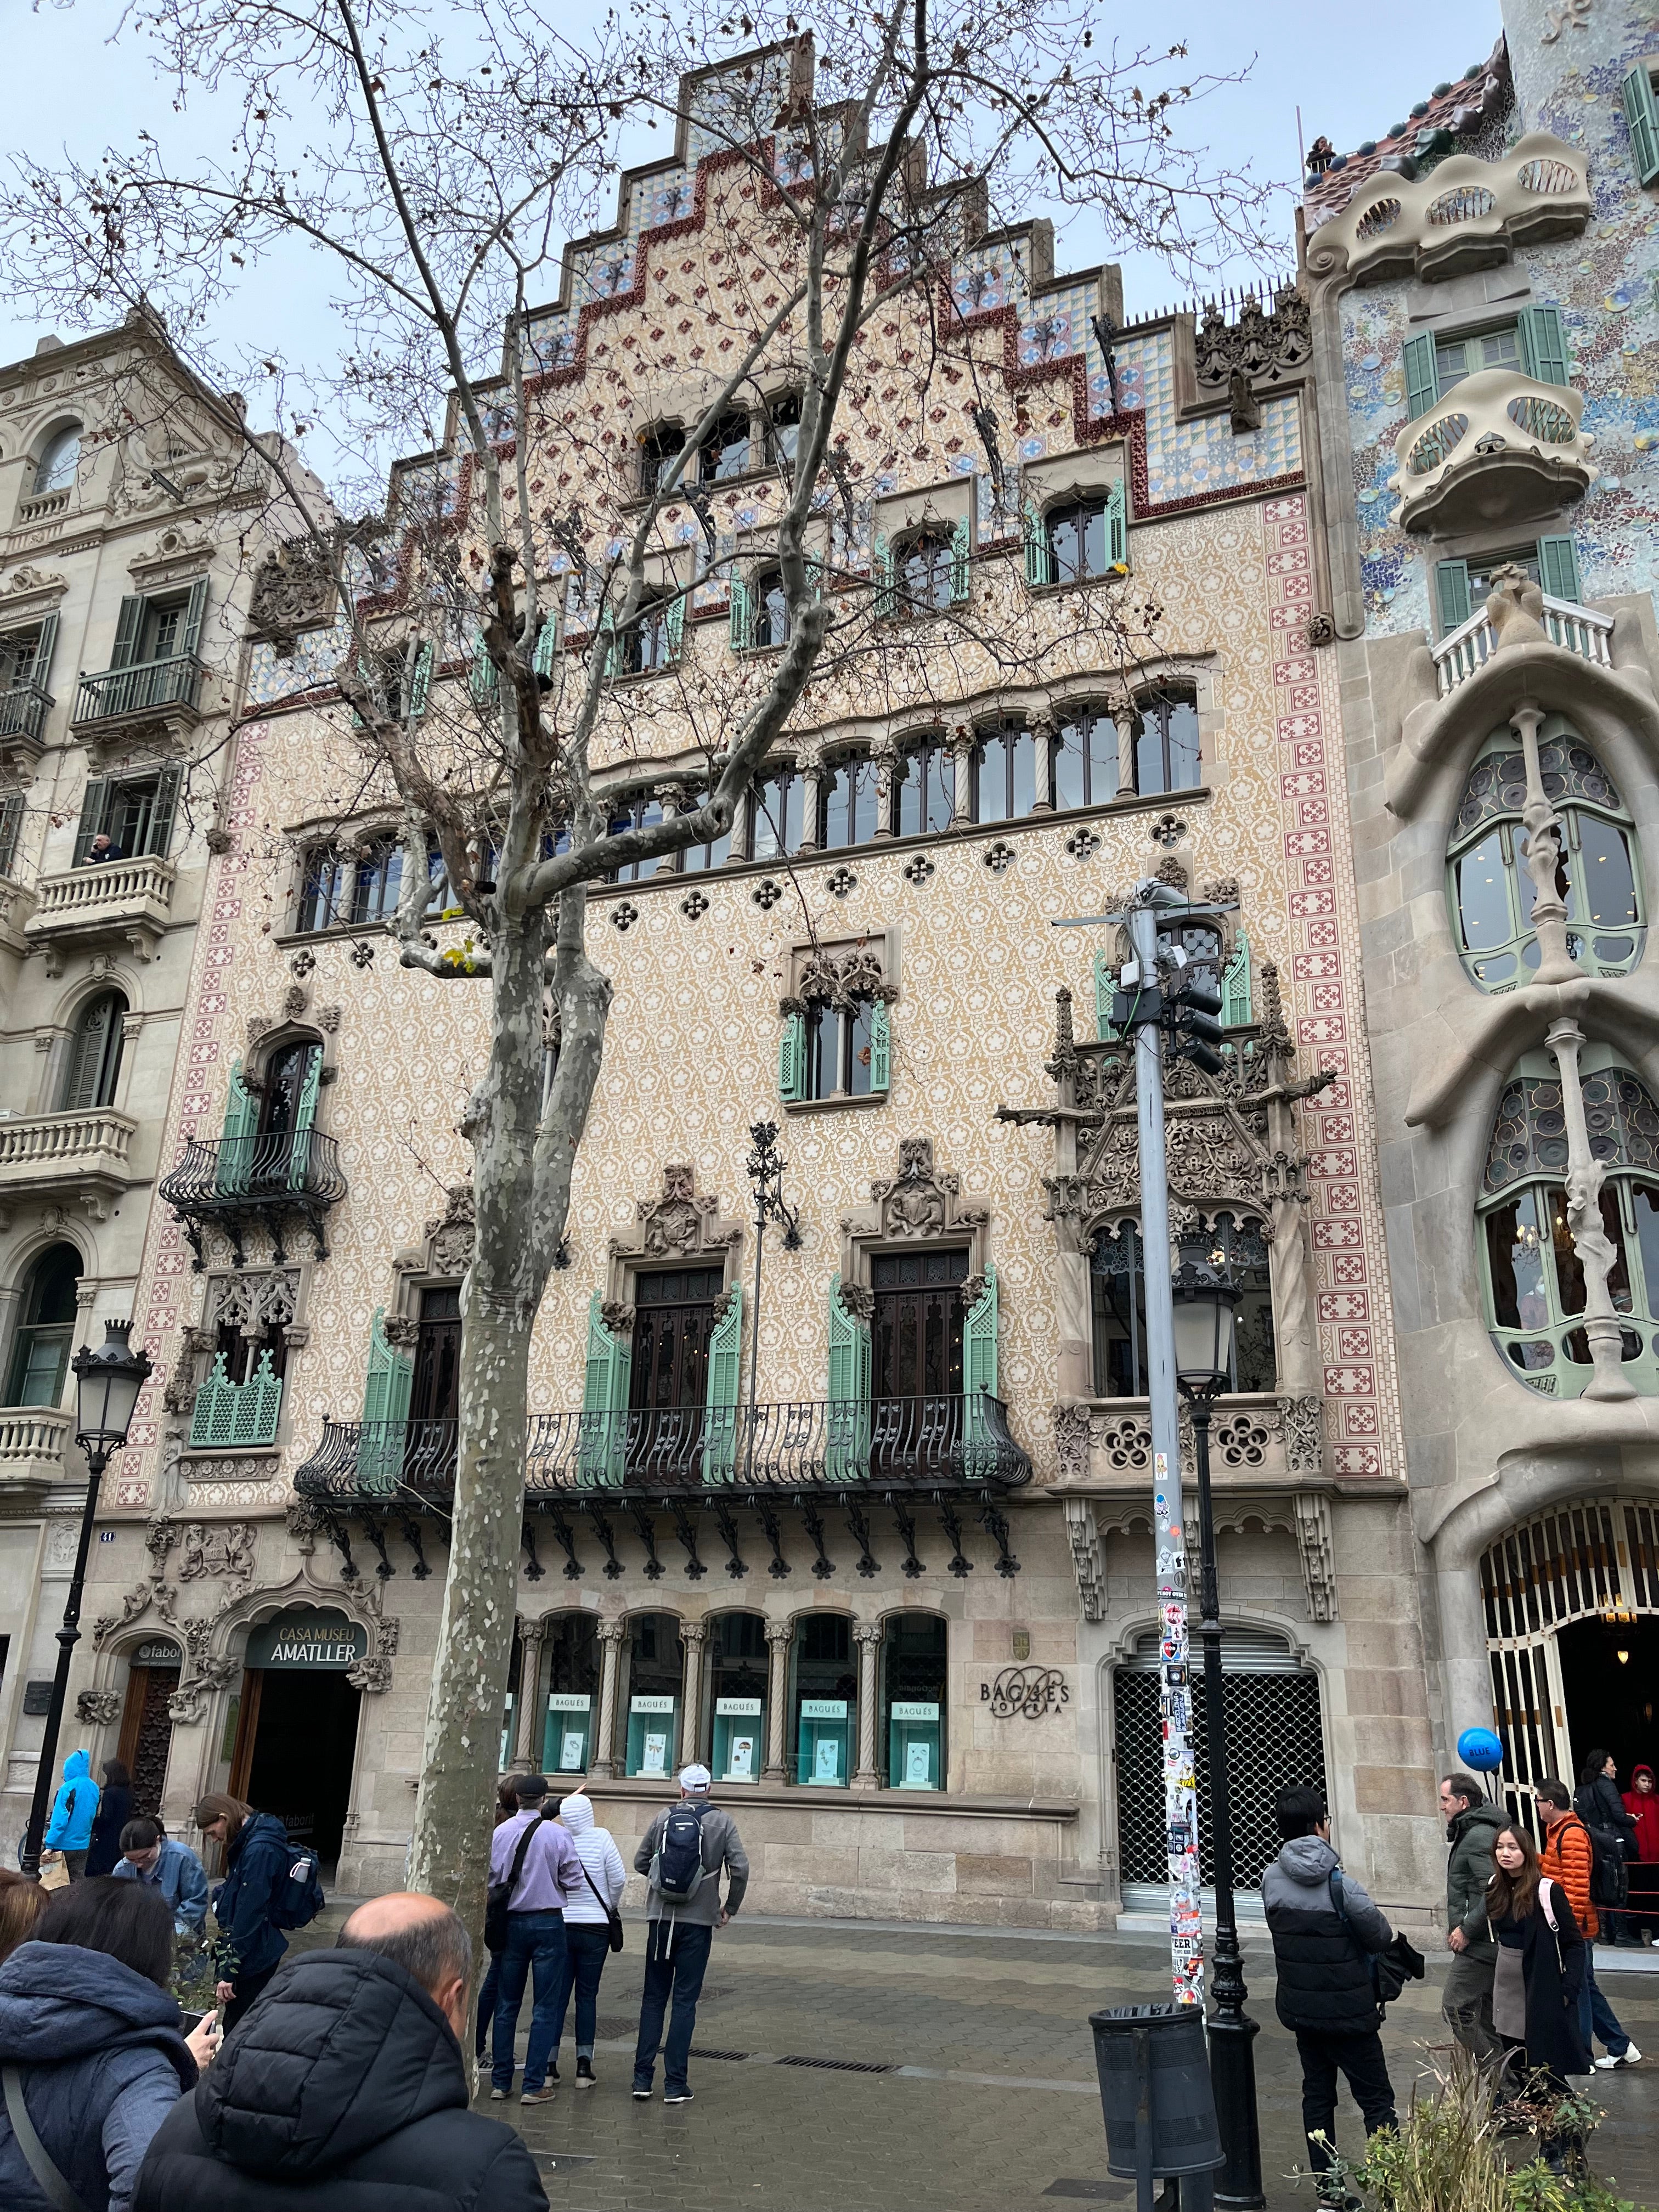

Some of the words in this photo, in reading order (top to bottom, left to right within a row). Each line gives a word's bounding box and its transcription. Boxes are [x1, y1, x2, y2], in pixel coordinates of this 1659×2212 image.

[103, 1532, 112, 1541] 41
[279, 1628, 312, 1641] CASA
[314, 1628, 354, 1641] MUSEU
[270, 1644, 356, 1662] AMATLLER
[1469, 1747, 1491, 1756] BLUE
